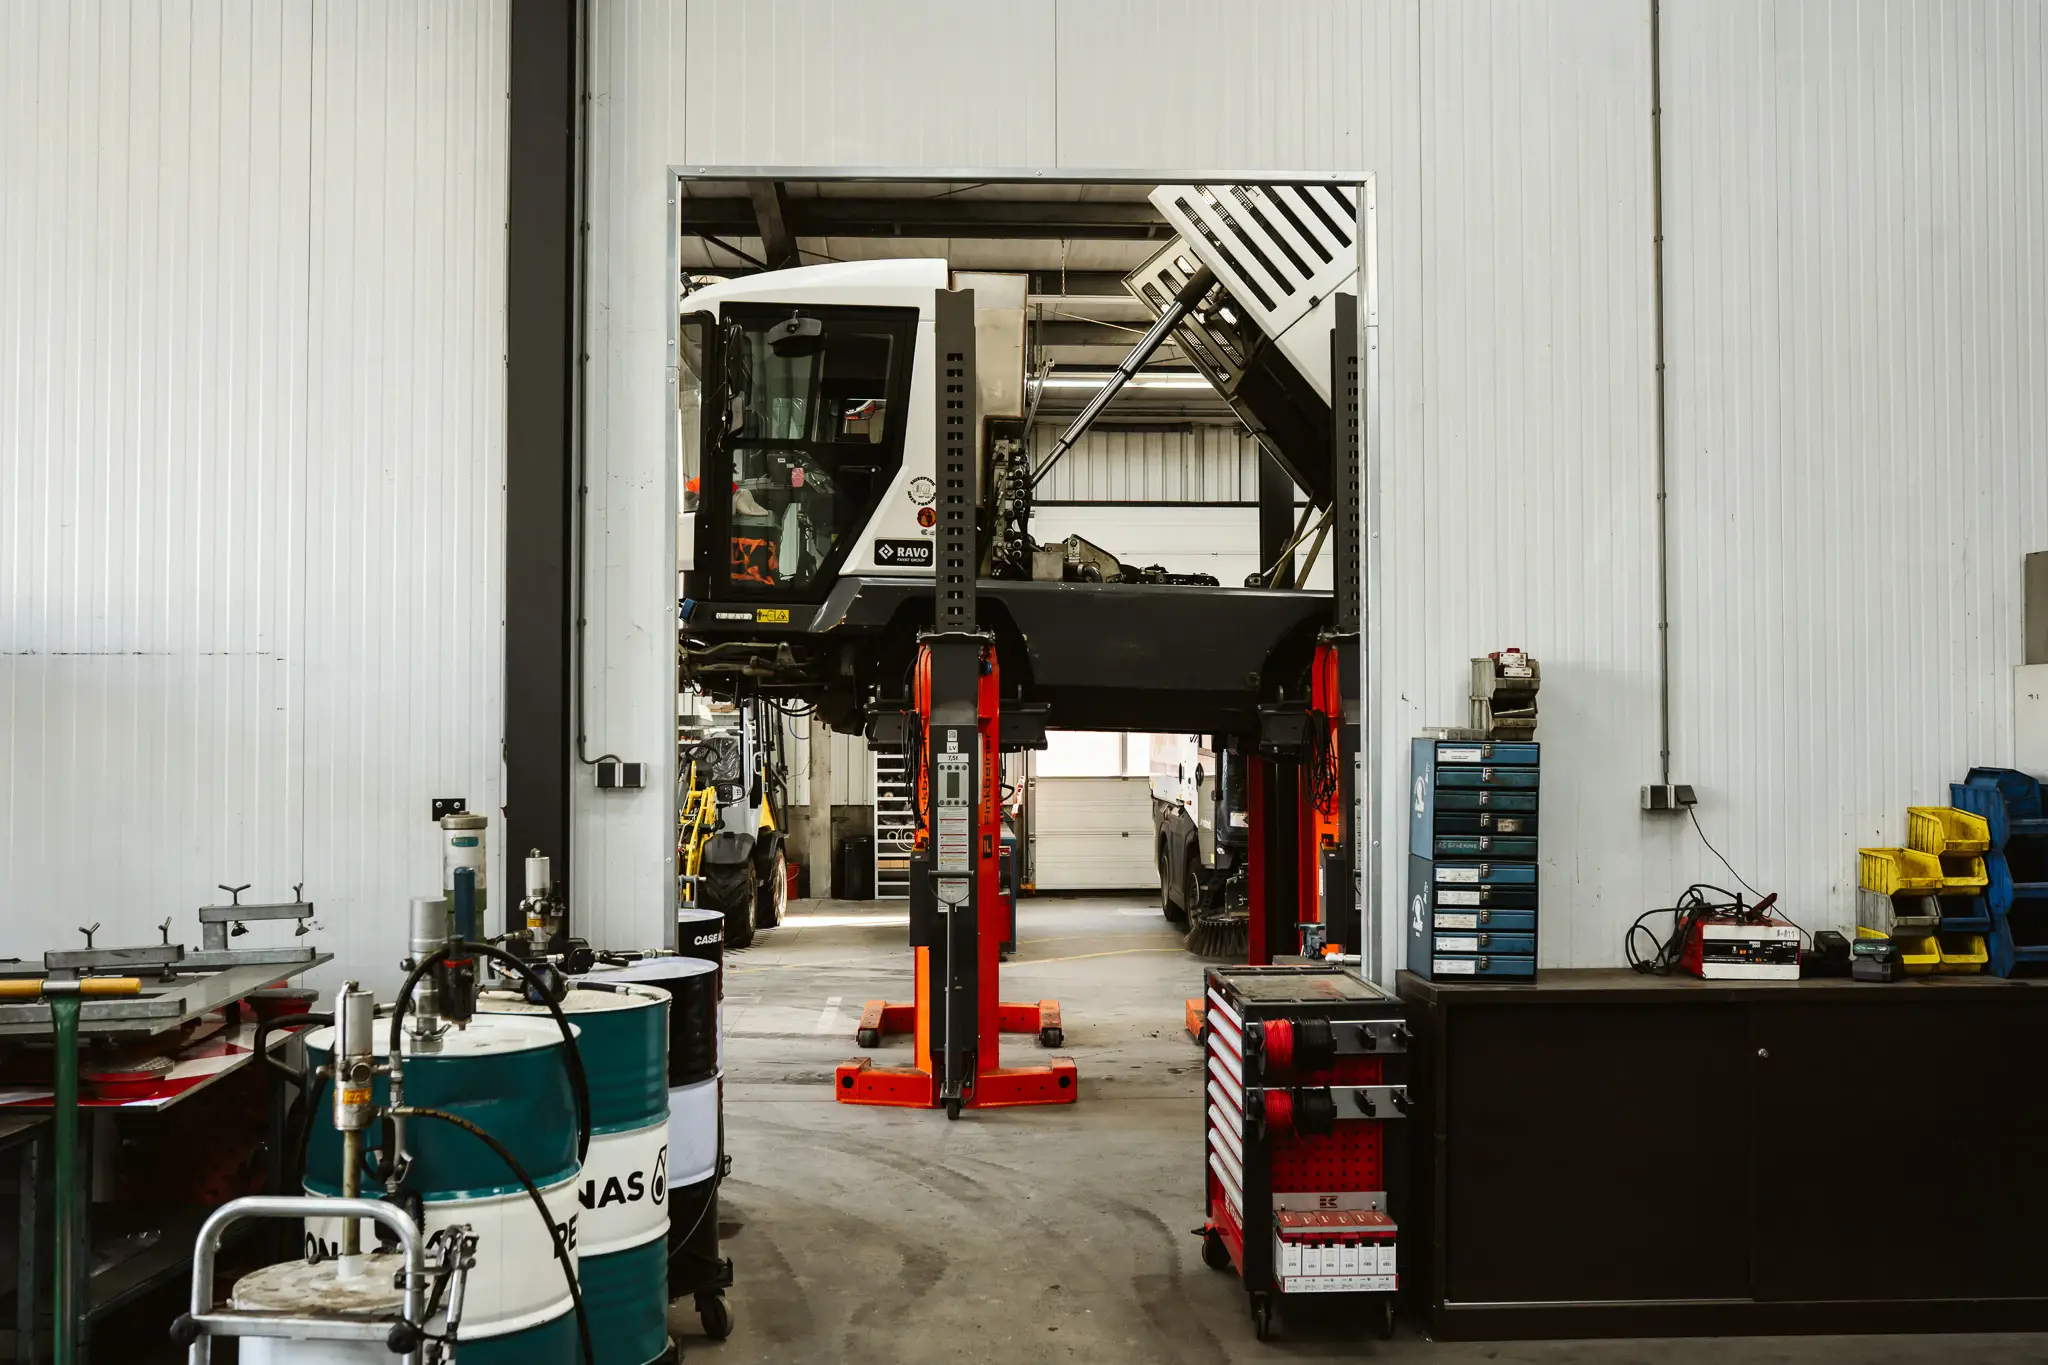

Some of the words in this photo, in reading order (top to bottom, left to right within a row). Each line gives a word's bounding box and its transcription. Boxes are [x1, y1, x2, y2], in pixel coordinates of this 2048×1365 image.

[897, 547, 929, 558] RAVO
[693, 933, 718, 946] CASE
[578, 1171, 645, 1210] NAS
